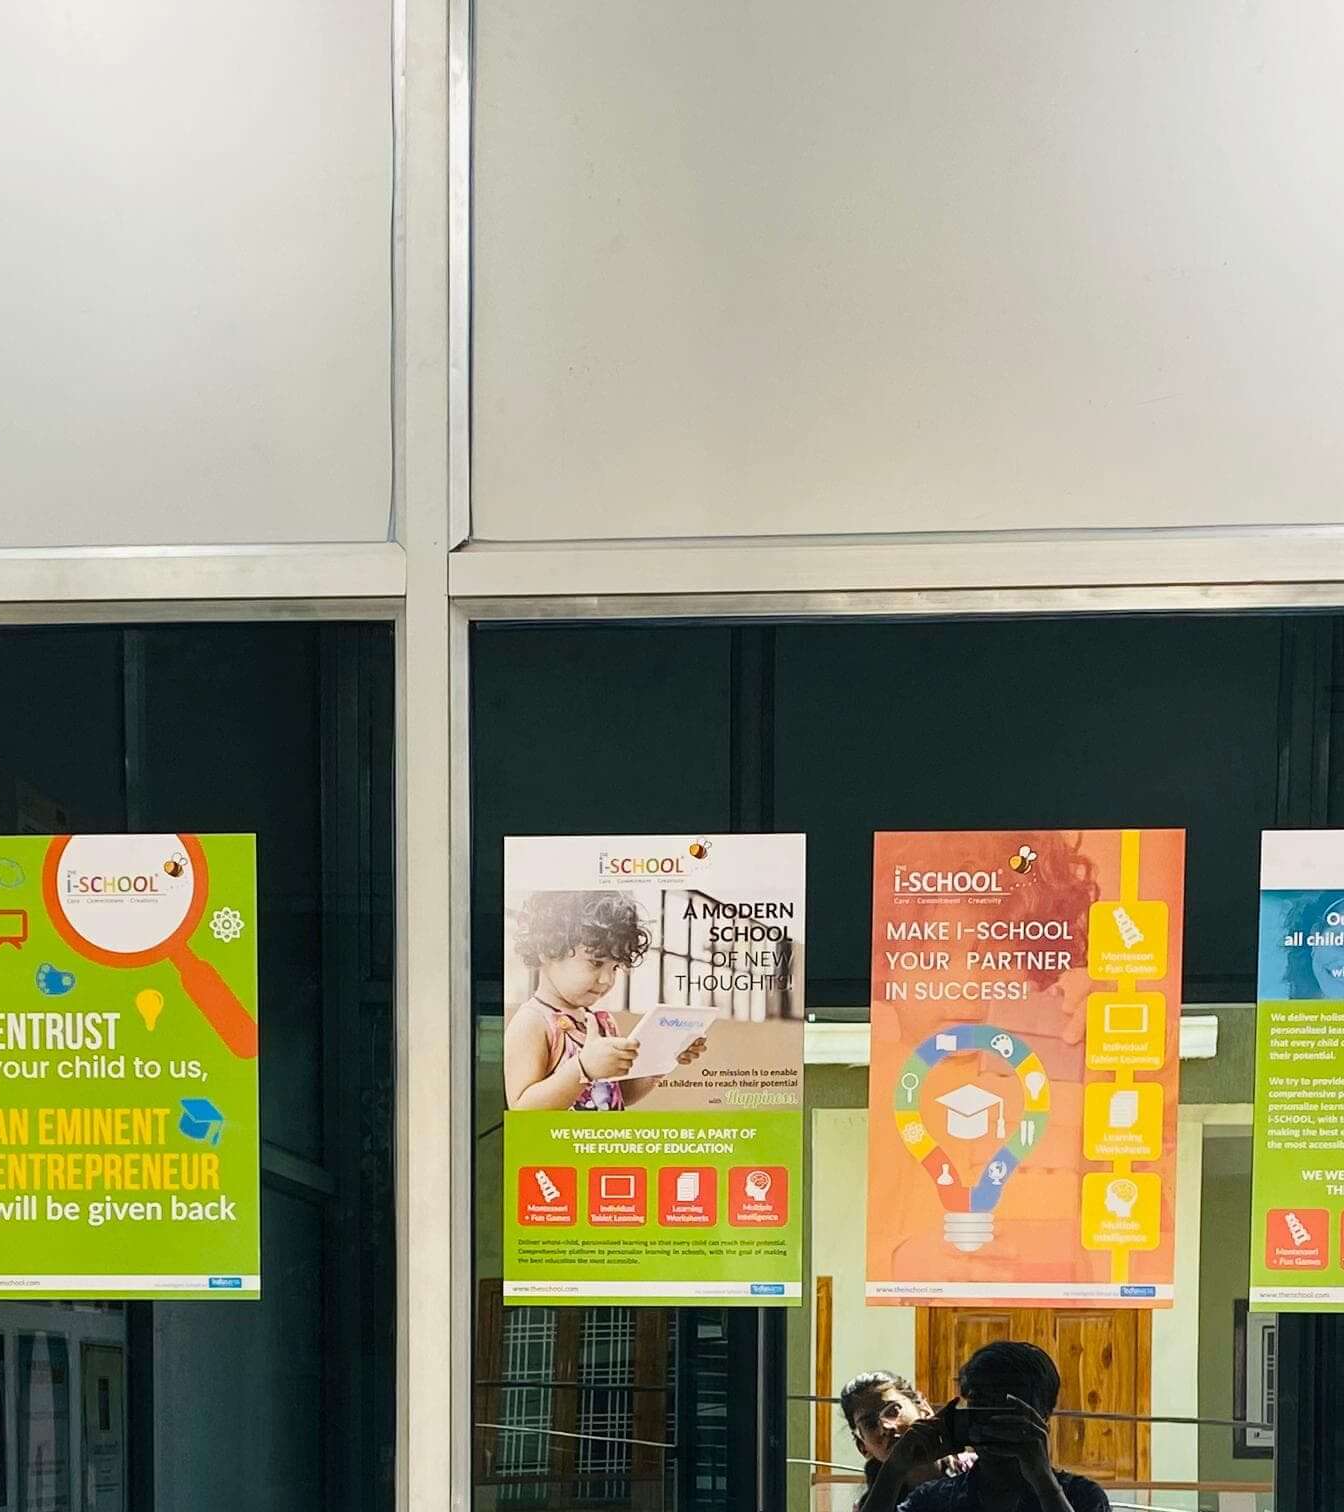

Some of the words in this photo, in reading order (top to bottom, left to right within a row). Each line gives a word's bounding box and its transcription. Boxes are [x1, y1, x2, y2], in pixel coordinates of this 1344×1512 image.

[599, 857, 684, 874] i-SCHOOL
[67, 875, 159, 893] i-SCHOOL
[894, 867, 1002, 893] i-SCHOOL
[683, 902, 698, 920] A
[702, 902, 794, 920] MODERN
[709, 926, 794, 943] SCHOOL
[886, 921, 950, 940] MAKE
[956, 921, 1073, 940] I-SCHOOL
[1284, 933, 1303, 947] all
[711, 951, 738, 968] OF
[744, 951, 794, 968] NEW
[885, 951, 950, 971] YOUR
[966, 951, 1072, 970] PARTNER
[675, 975, 794, 992] THOUGHTS!
[885, 981, 906, 1001] IN
[914, 981, 1029, 1001] SUCCESS!
[57, 1055, 125, 1079] child
[133, 1057, 161, 1079] to
[170, 1060, 208, 1083] us,
[701, 1068, 717, 1077] Our
[719, 1068, 749, 1077] mission
[751, 1069, 758, 1077] is
[760, 1069, 769, 1077] to
[771, 1068, 797, 1077] enable
[658, 1079, 668, 1088] all
[669, 1079, 703, 1088] children
[704, 1080, 713, 1088] to
[714, 1079, 738, 1088] reach
[739, 1079, 759, 1088] their
[760, 1079, 798, 1090] potential
[725, 1088, 799, 1108] Happiness.
[38, 1108, 170, 1145] EMINENT
[550, 1129, 572, 1139] WE
[572, 1129, 633, 1139] WELCOME
[633, 1129, 661, 1139] YOU
[662, 1129, 679, 1139] TO
[680, 1129, 696, 1139] BE
[697, 1129, 706, 1139] A
[708, 1129, 738, 1139] PART
[740, 1129, 757, 1139] OF
[574, 1143, 597, 1154] THE
[598, 1143, 644, 1154] FUTURE
[645, 1143, 663, 1154] OF
[664, 1143, 734, 1154] EDUCATION
[1302, 1170, 1323, 1181] WE
[46, 1195, 81, 1221] be
[88, 1196, 163, 1226] given
[171, 1195, 237, 1221] back
